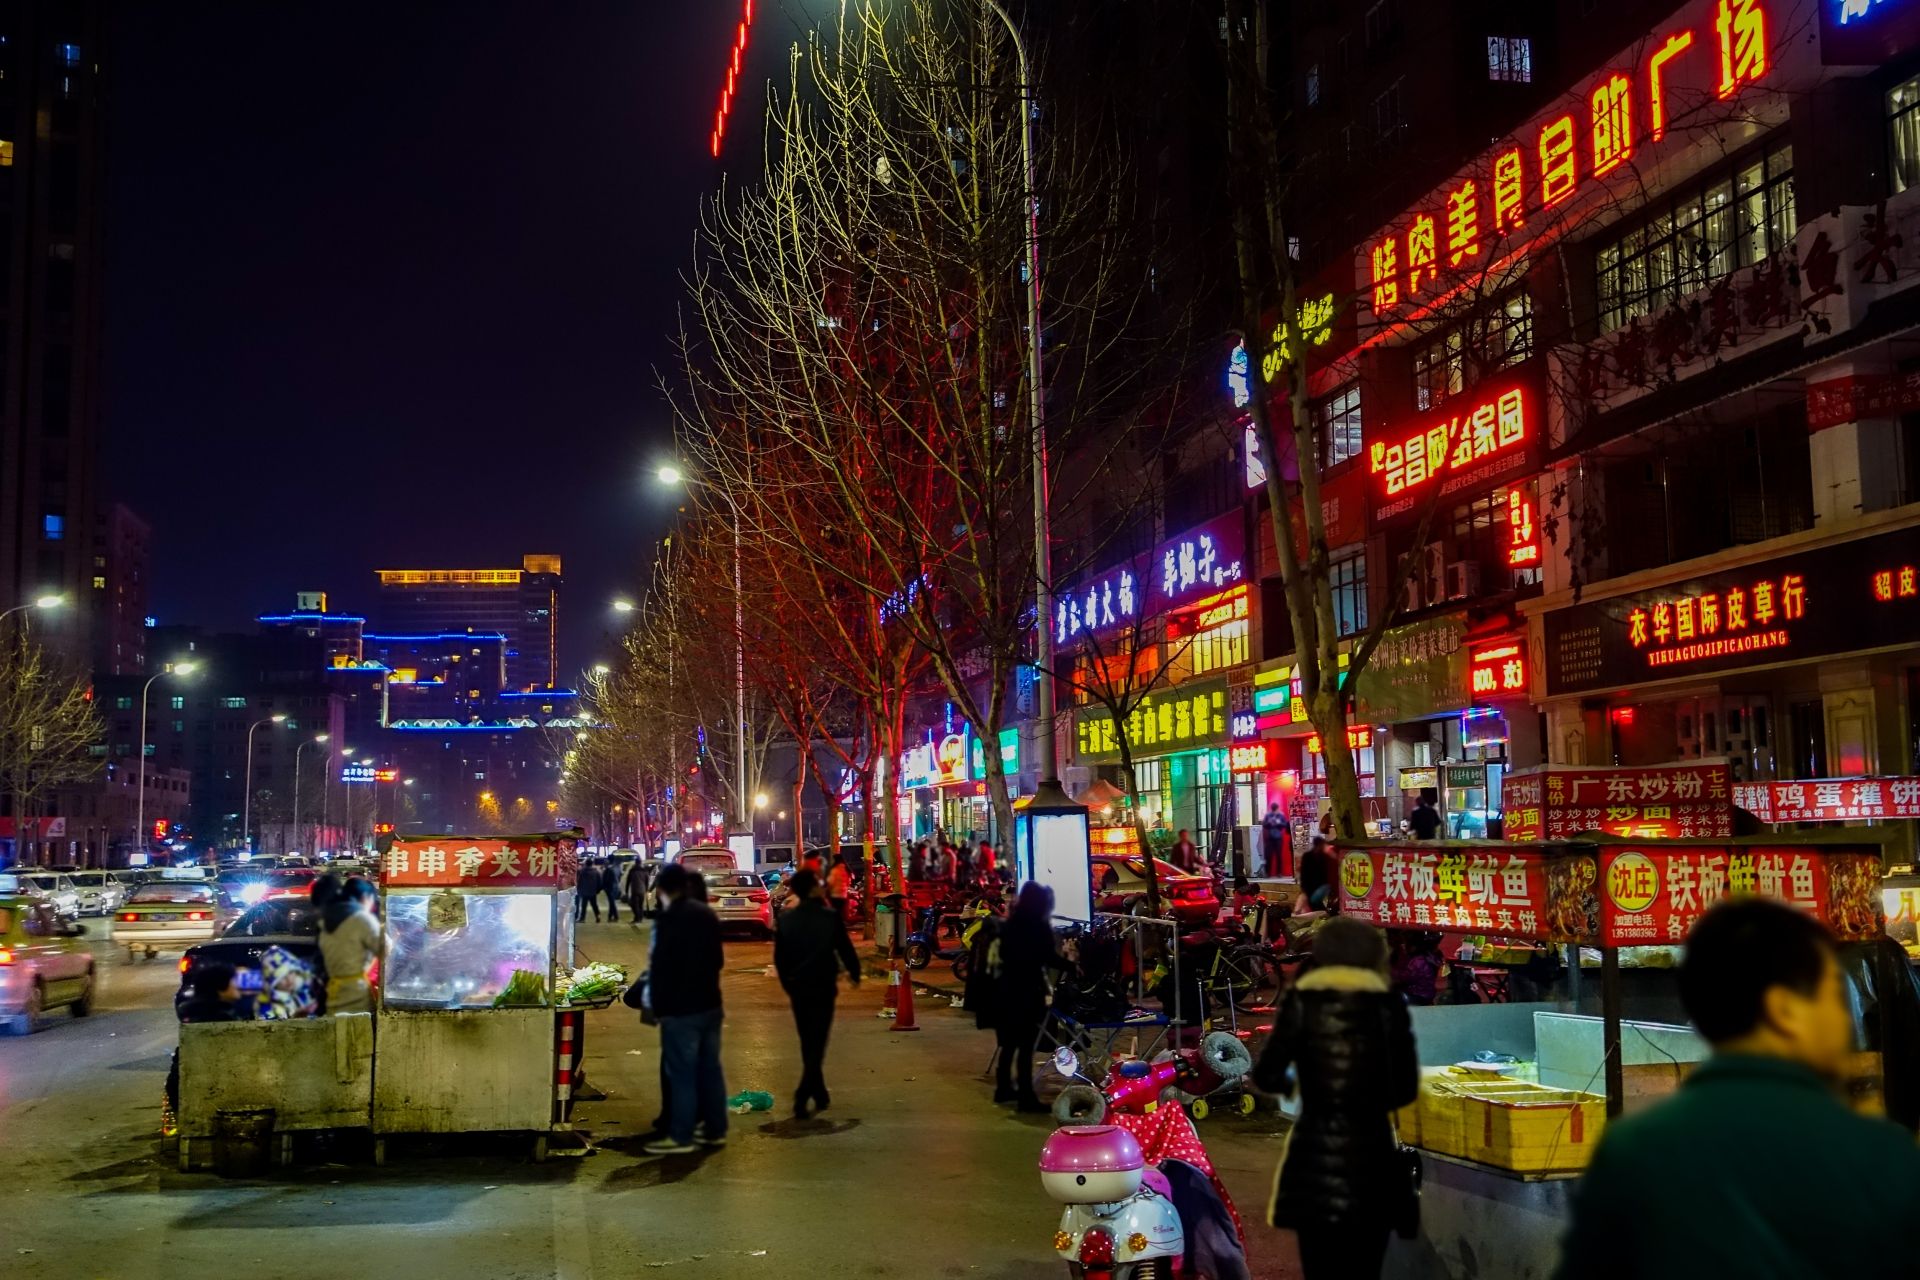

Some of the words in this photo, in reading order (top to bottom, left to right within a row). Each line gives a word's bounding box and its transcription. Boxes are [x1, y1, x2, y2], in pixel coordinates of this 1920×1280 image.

[1629, 576, 1805, 647] 衣华国际皮草行
[1648, 631, 1788, 666] YIHUAGUOJIPICAOHANG
[1503, 778, 1542, 809] 广东炒粉
[1570, 771, 1704, 804] 广东炒粉
[1776, 780, 1920, 809] 鸡蛋灌饼
[1505, 808, 1540, 829] 炒面
[1605, 803, 1671, 821] 炒面
[385, 845, 558, 880] 串串香夹饼
[1381, 852, 1532, 906] 铁板鲜鱿鱼
[1612, 863, 1653, 899] 沈庄
[1666, 854, 1818, 911] 铁板鲜鱿鱼
[1378, 902, 1538, 934] 各种蔬菜肉串夹饼
[1612, 928, 1658, 939] 13513803962
